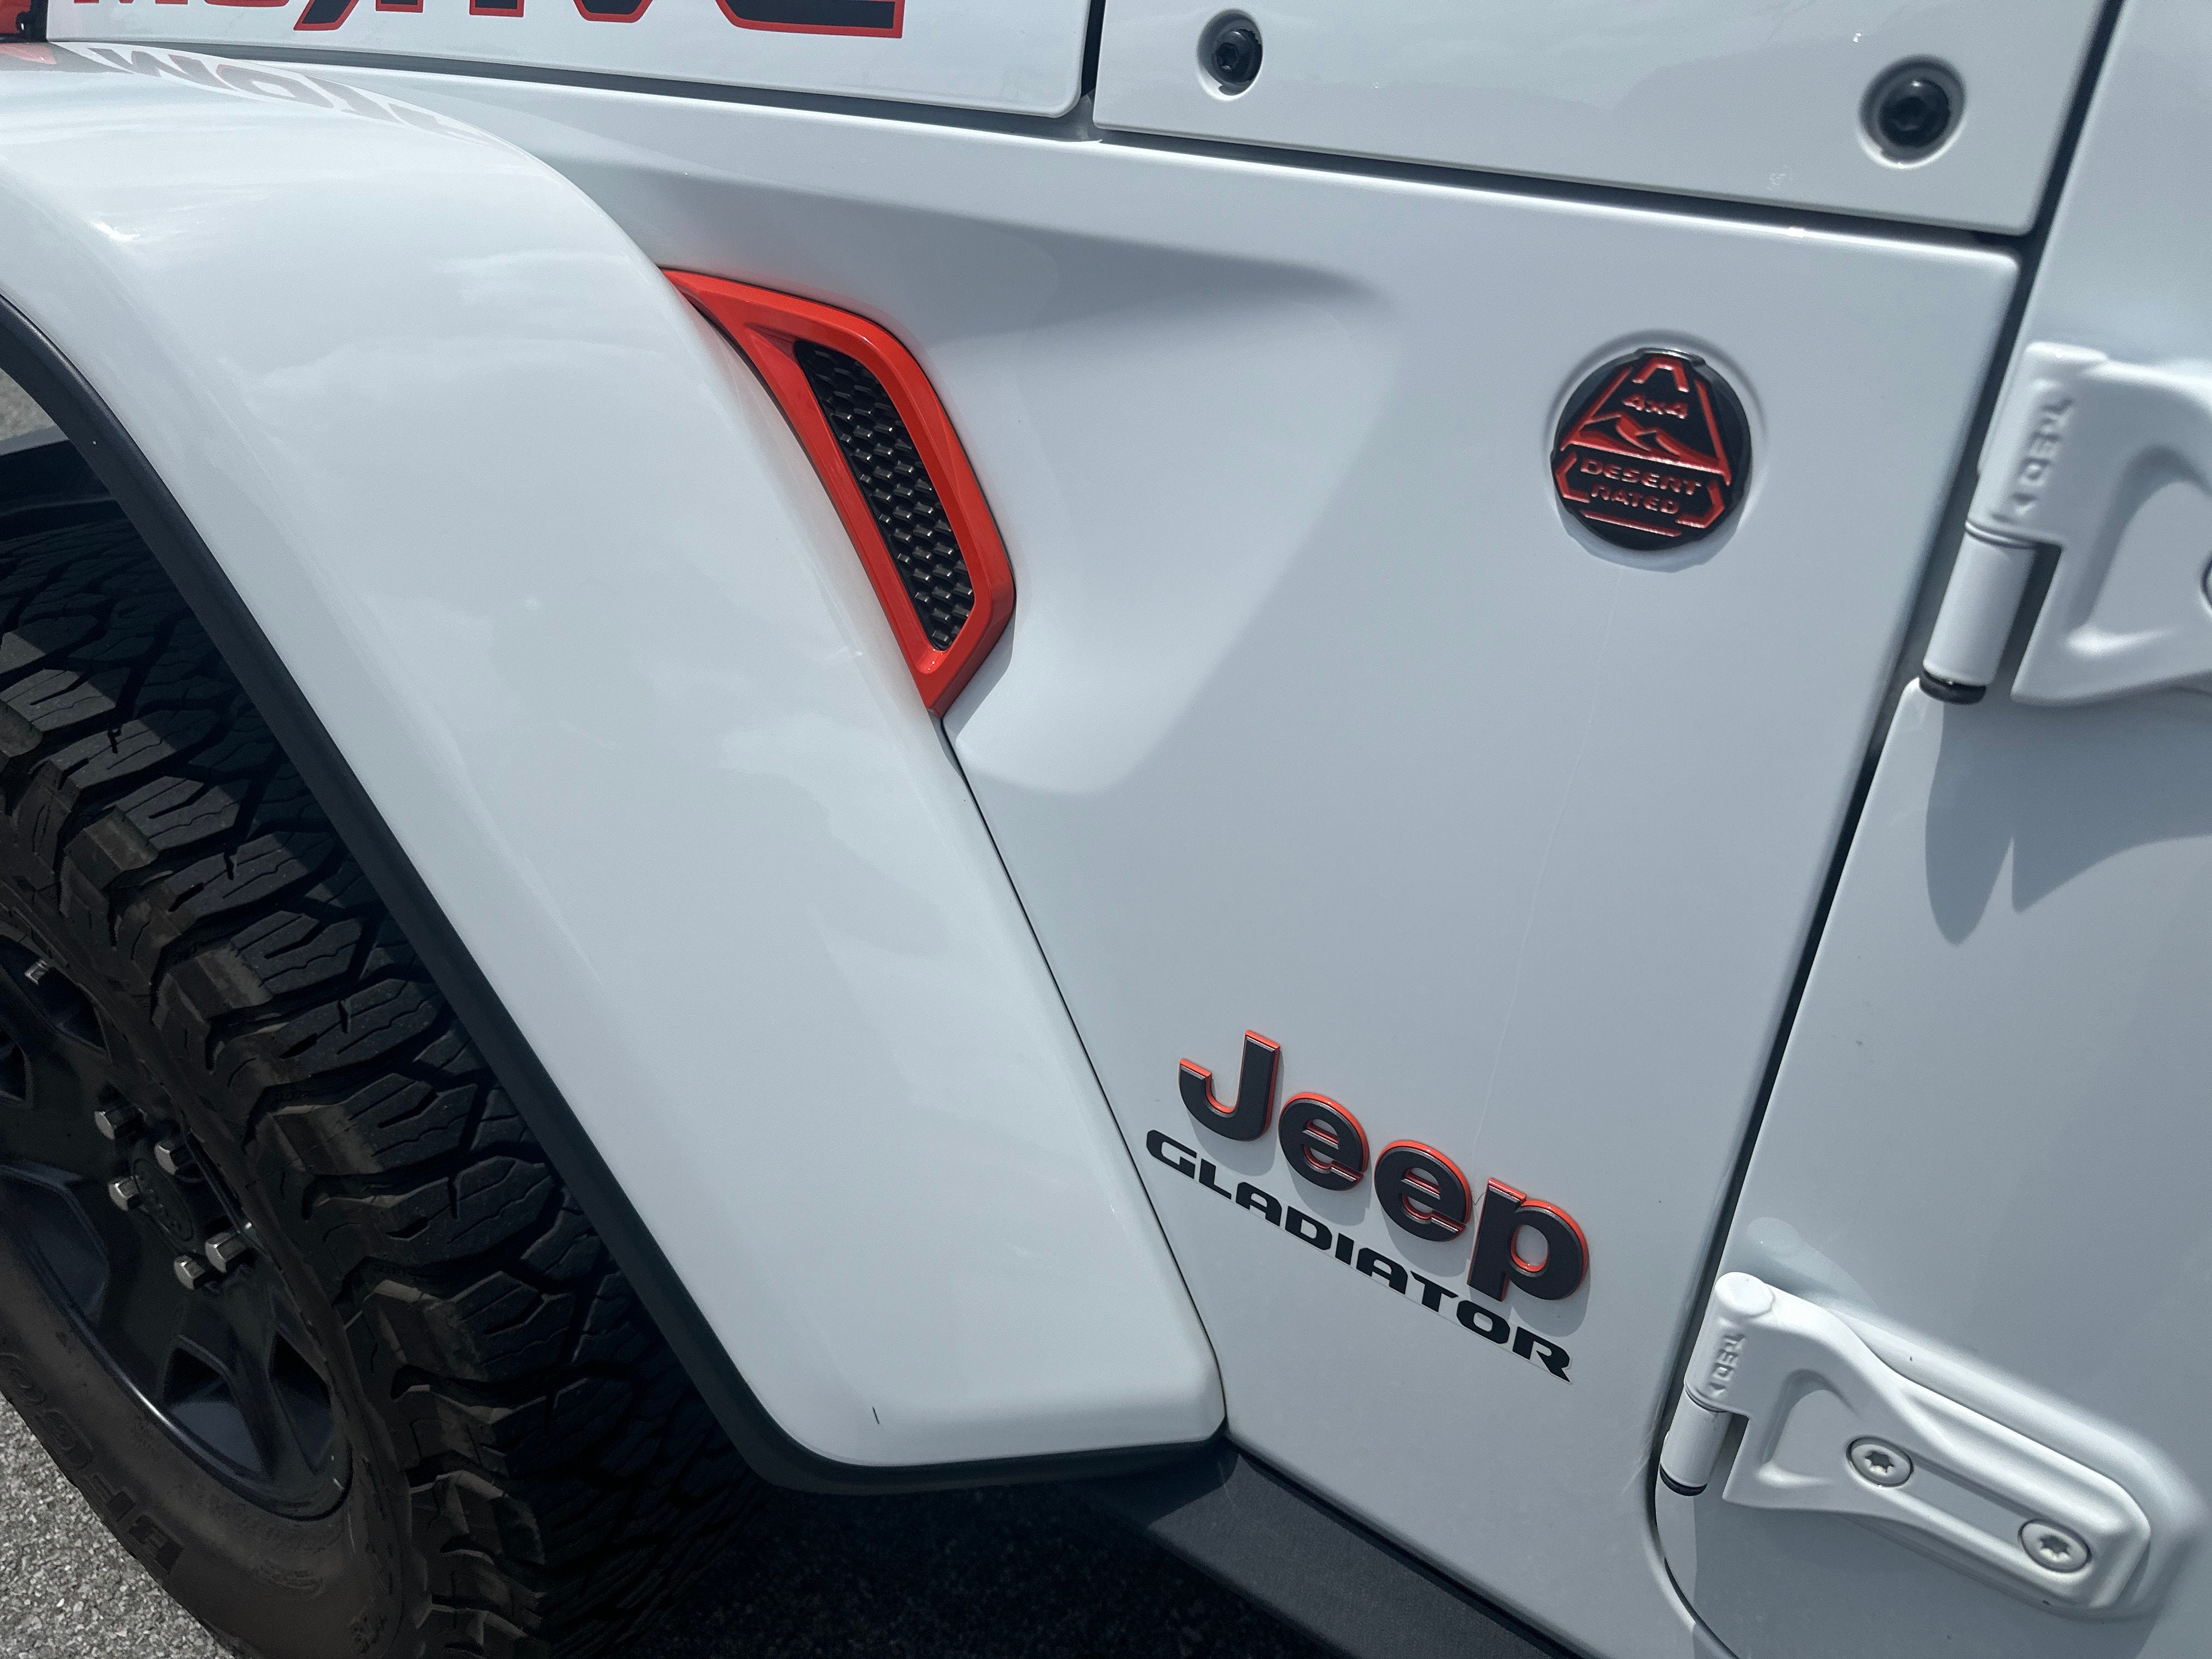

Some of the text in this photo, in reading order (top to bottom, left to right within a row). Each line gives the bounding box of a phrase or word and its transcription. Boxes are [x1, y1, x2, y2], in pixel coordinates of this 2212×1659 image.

[1622, 393, 1688, 419] 4x4
[1580, 458, 1702, 495] DESERT
[1591, 483, 1680, 515] RATED
[1178, 1030, 1589, 1301] Jeep
[1146, 1129, 1572, 1383] GLADIATOR
